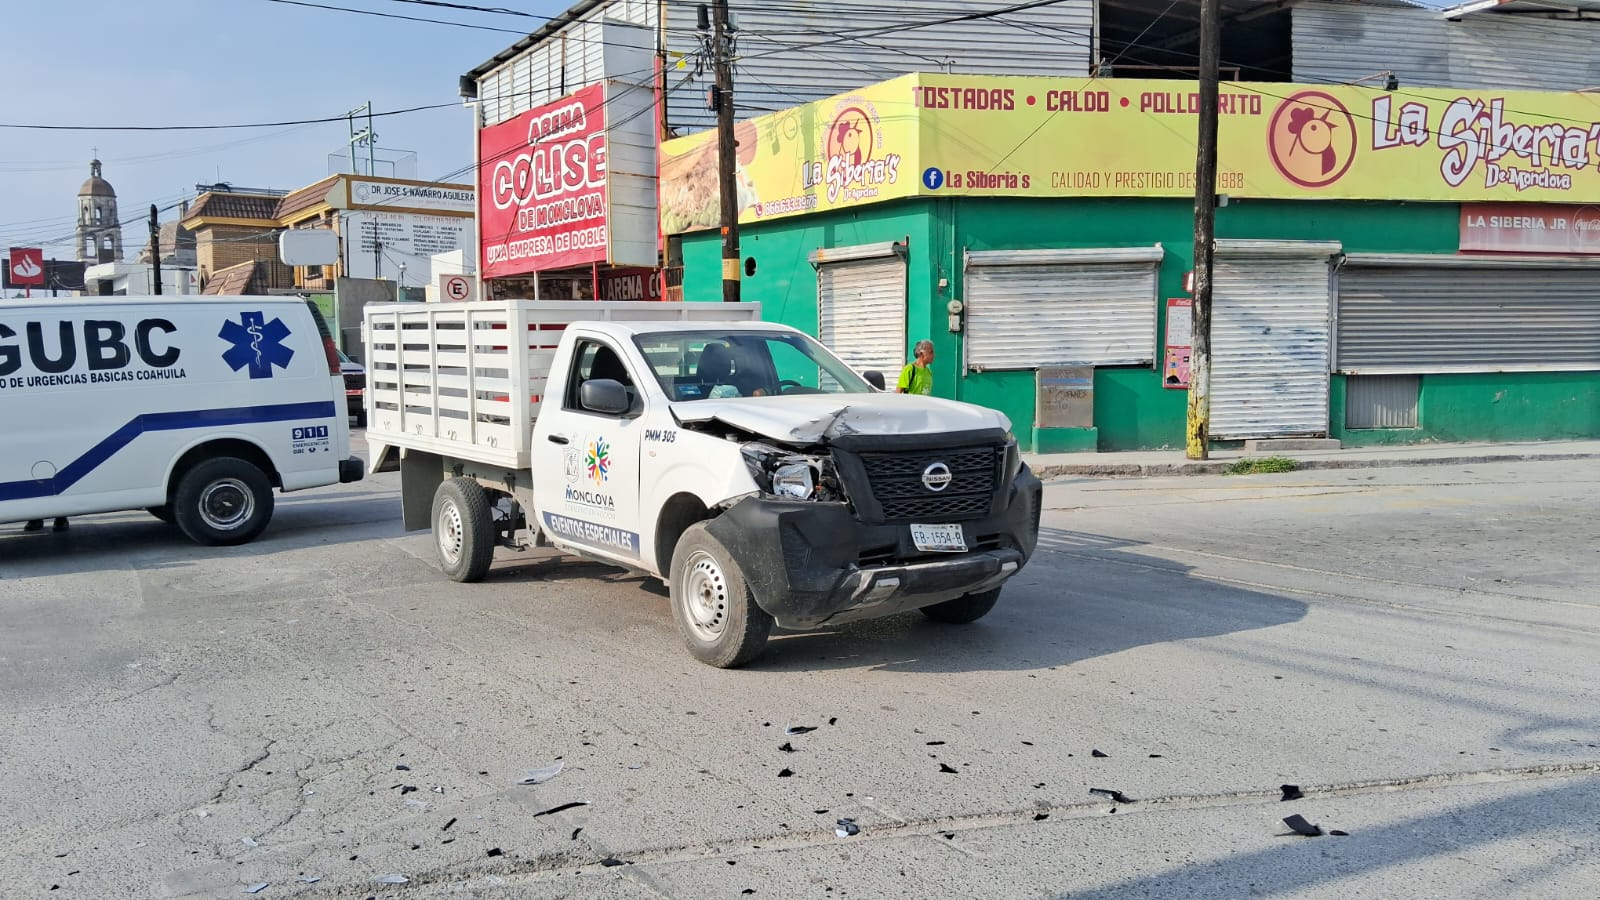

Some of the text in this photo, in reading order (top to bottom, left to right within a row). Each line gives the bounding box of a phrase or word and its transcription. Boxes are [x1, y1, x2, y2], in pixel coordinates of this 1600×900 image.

[912, 86, 1262, 116] TOSTADAS CALDO POLLO RITO
[528, 102, 586, 146] ARENA
[1372, 94, 1600, 188] La Siberia'
[802, 152, 900, 204] La Siberia's
[946, 170, 962, 189] La
[1051, 171, 1101, 189] CALIDAD
[1105, 172, 1112, 188] Y
[1115, 171, 1175, 190] PRESTIGIO
[1217, 172, 1245, 189] 1988
[1485, 163, 1572, 191] De Monclova
[371, 185, 381, 194] DR
[383, 185, 400, 196] JOSE
[410, 187, 441, 199] NAVARRO
[442, 191, 475, 201] AGUILERA
[519, 192, 605, 232] DE MONCLOVA
[1466, 215, 1567, 230] LA SIBERIA JR
[487, 225, 606, 263] UNA EMPRESA DE DOBLE
[607, 274, 644, 301] ARENA
[10, 377, 24, 388] DE
[27, 373, 88, 387] URGENCIAS
[90, 370, 134, 383] BASICAS
[136, 368, 187, 380] COAHUILA
[294, 427, 327, 439] 911
[645, 429, 677, 443] PMM 305
[565, 484, 615, 507] MONCLOVA
[551, 515, 632, 549] EVENTOS ESPECIALES
